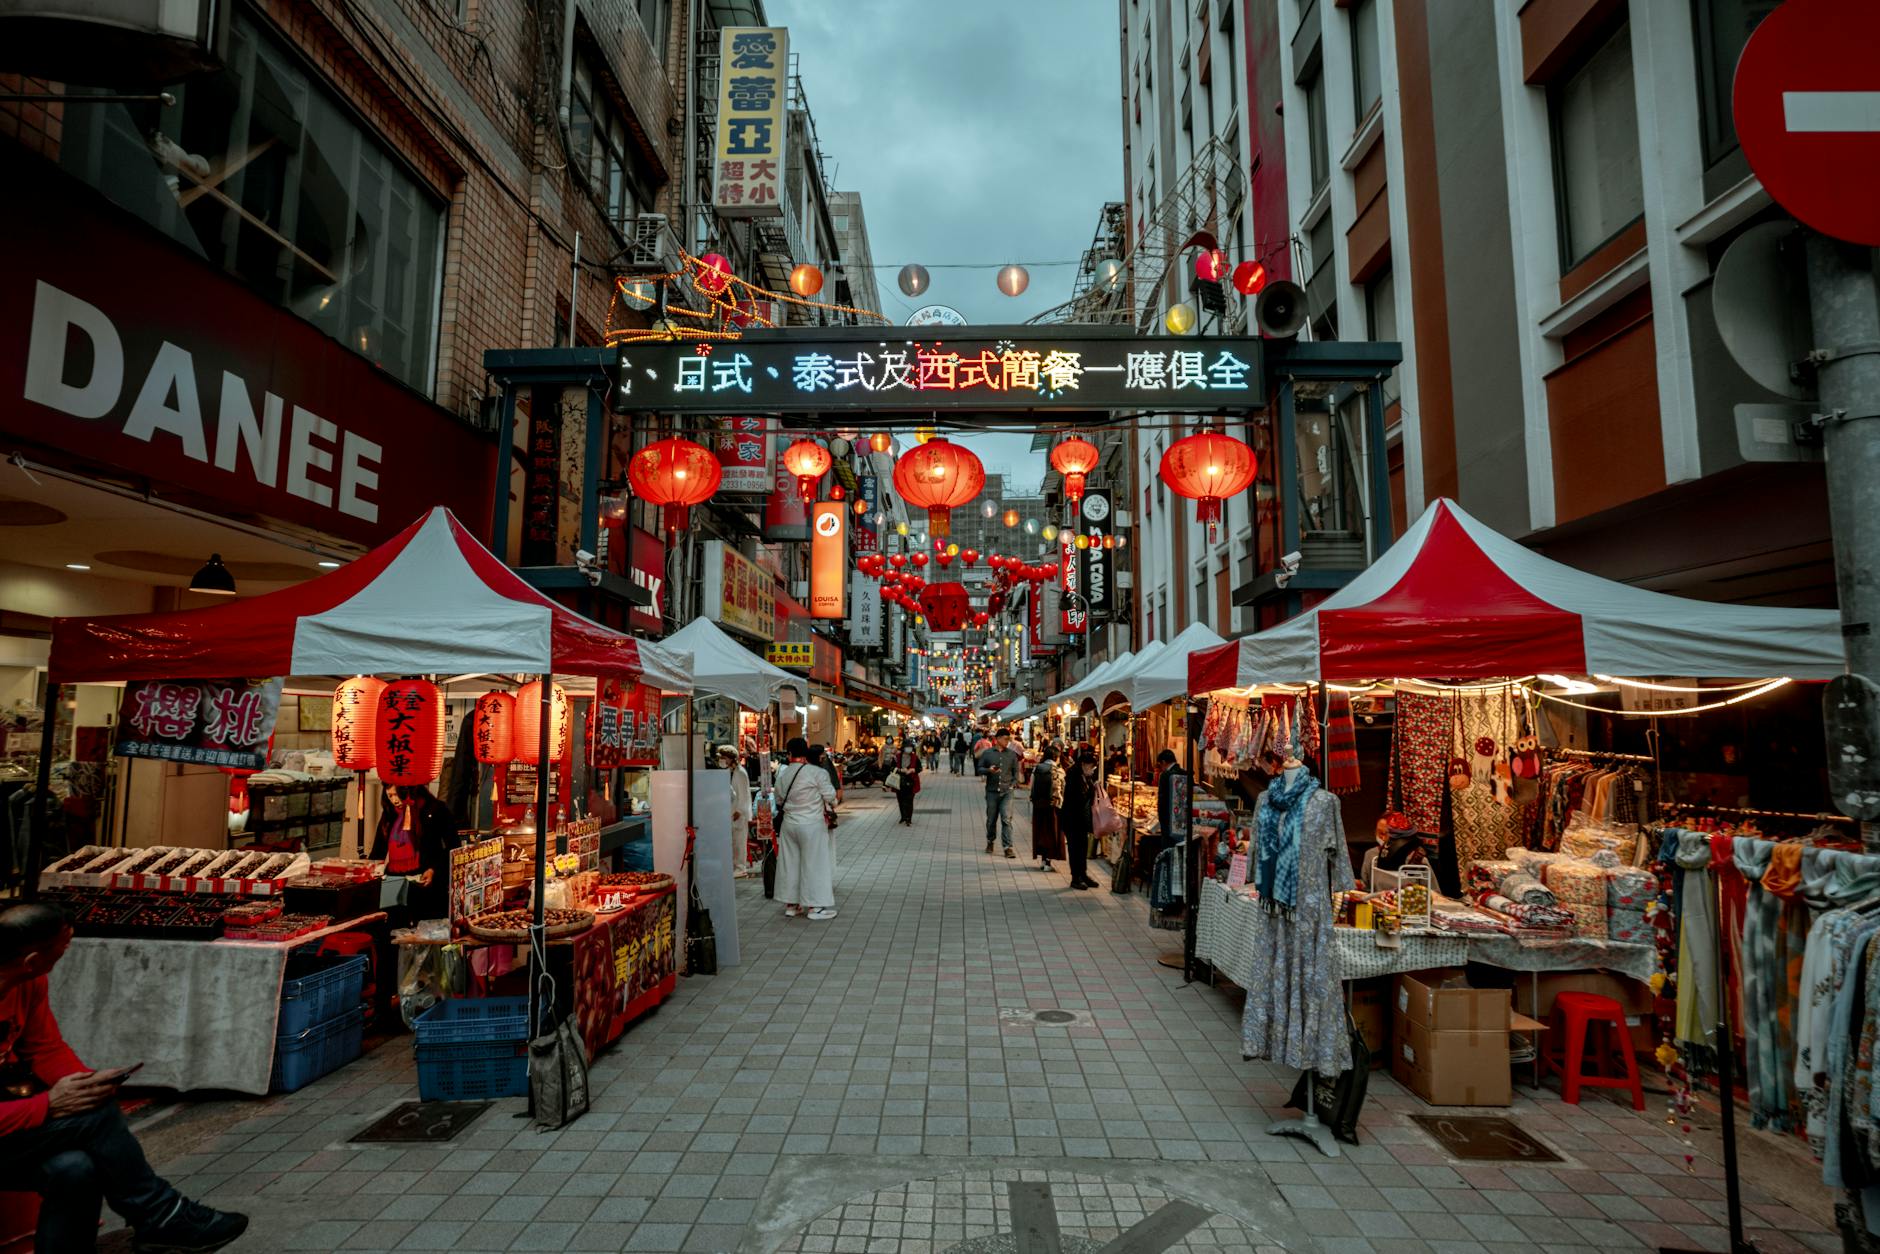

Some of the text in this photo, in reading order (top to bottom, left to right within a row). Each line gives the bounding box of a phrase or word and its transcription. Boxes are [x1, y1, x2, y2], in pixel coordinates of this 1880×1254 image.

[727, 32, 776, 155] 愛蕾亞
[24, 279, 382, 523] DANEE
[621, 351, 1250, 395] 、日式、泰式及西式簡餐一應俱全
[130, 682, 264, 746] 櫻桃
[386, 711, 416, 777] 大板栗
